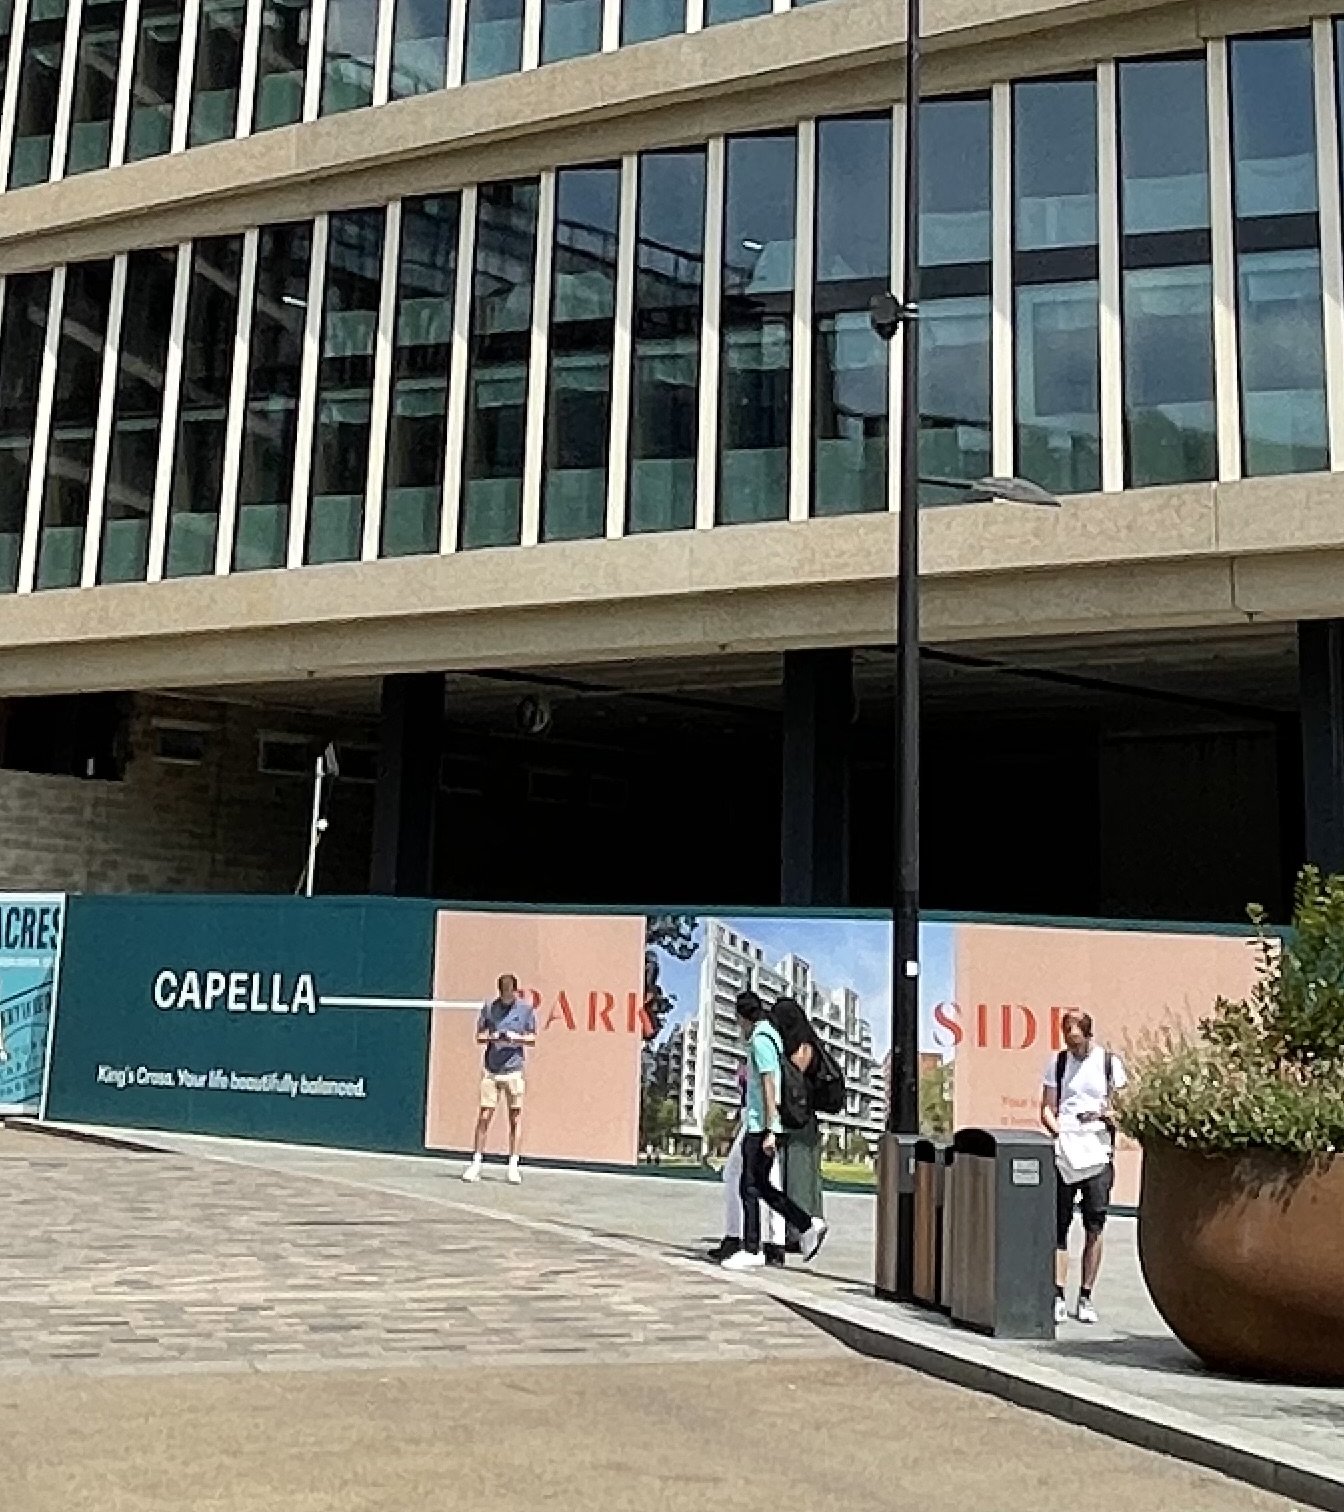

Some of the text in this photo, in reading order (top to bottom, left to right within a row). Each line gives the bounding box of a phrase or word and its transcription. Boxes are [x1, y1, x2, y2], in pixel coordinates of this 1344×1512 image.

[154, 970, 317, 1014] CAPELLA
[97, 1064, 135, 1089] King's
[177, 1068, 207, 1088] Your
[208, 1068, 230, 1090] life
[230, 1071, 299, 1098] beautifully
[300, 1074, 368, 1098] balanced.
